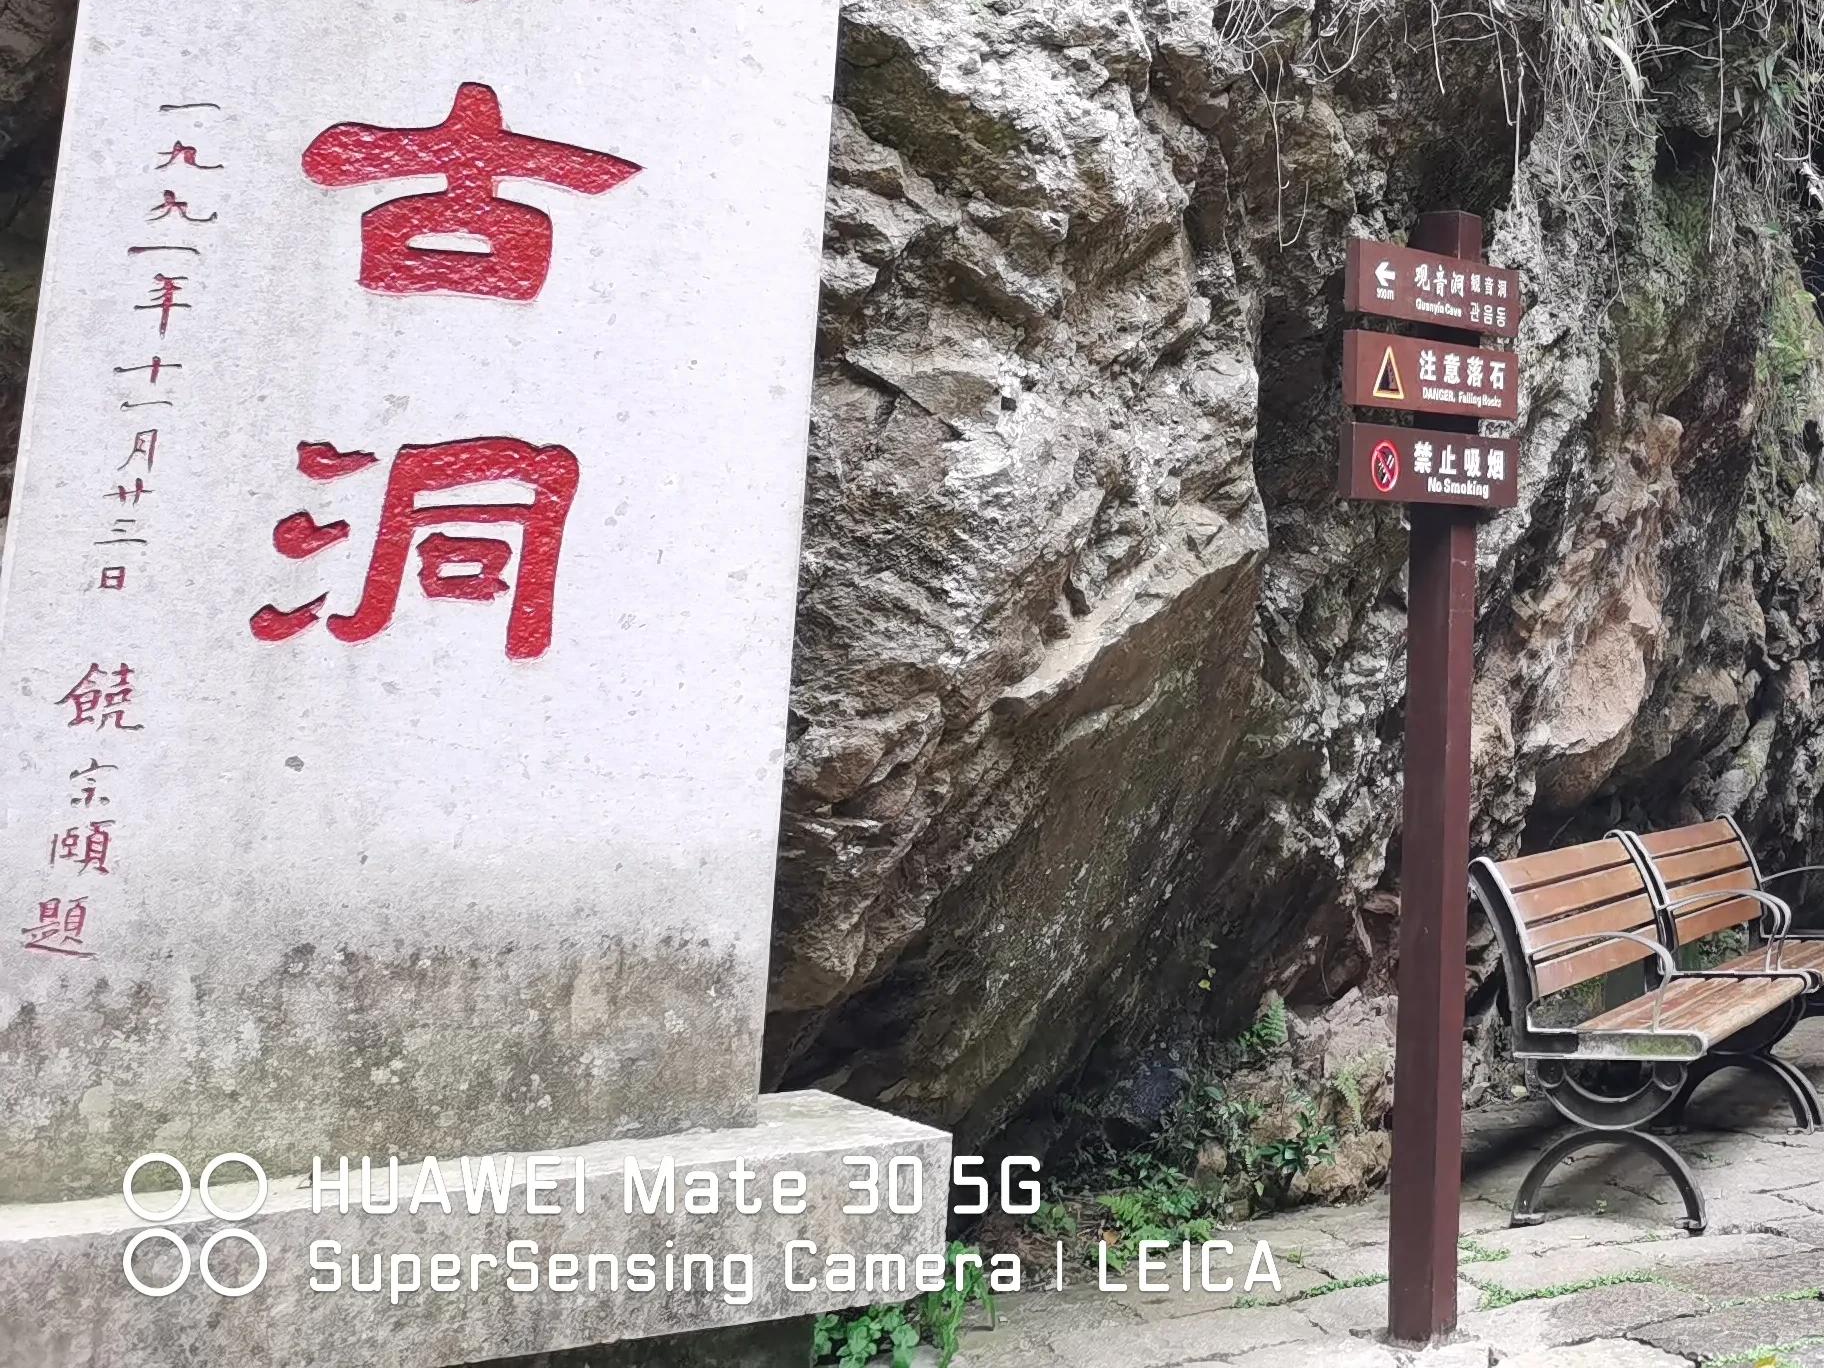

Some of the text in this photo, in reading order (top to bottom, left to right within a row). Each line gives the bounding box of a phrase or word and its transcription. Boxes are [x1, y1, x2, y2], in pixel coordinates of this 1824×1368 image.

[1414, 263, 1465, 298] 观音洞
[1415, 298, 1462, 317] Guanyin Cave
[1470, 302, 1507, 328] 관음동
[1419, 349, 1506, 390] 注意落石
[1458, 391, 1482, 408] Falling
[1413, 440, 1506, 481] 禁止吸烟
[1427, 476, 1490, 499] No Smoking
